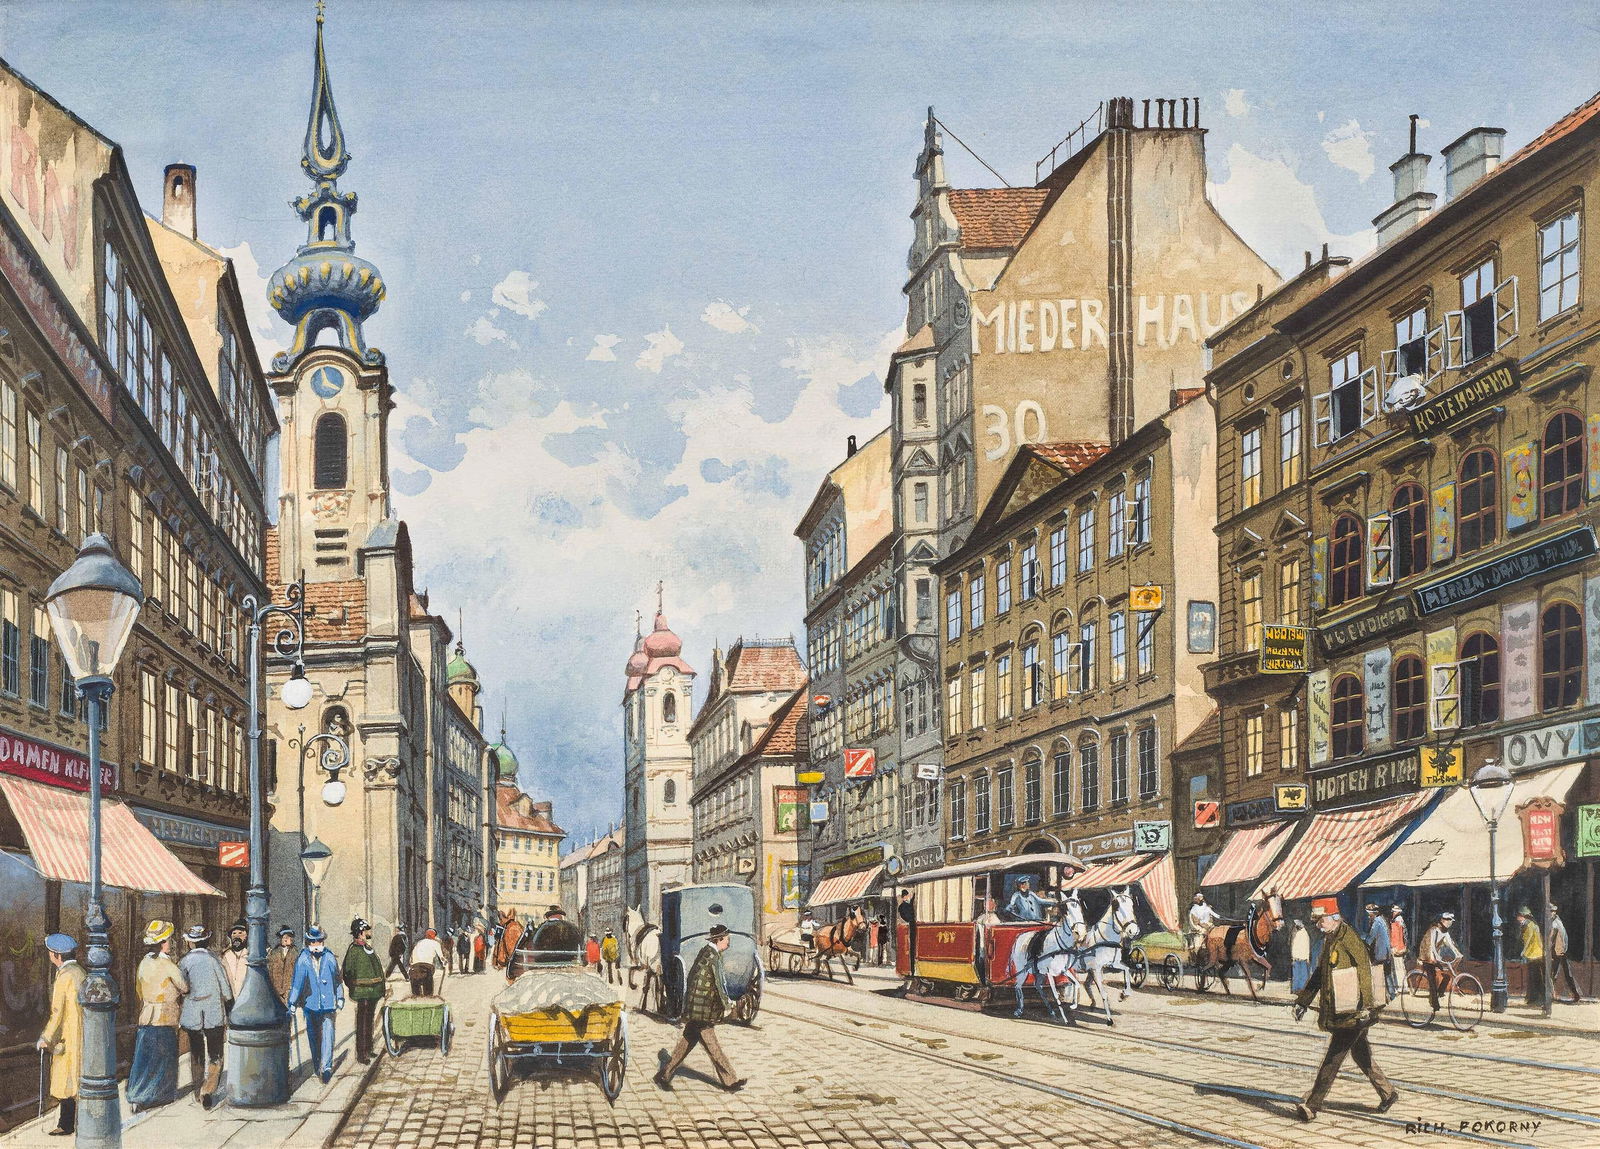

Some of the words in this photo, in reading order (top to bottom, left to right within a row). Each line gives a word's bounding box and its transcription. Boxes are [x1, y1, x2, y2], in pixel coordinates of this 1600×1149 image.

[970, 298, 1110, 355] MIEDER
[982, 399, 1047, 461] 30
[0, 736, 60, 774] DAMEN
